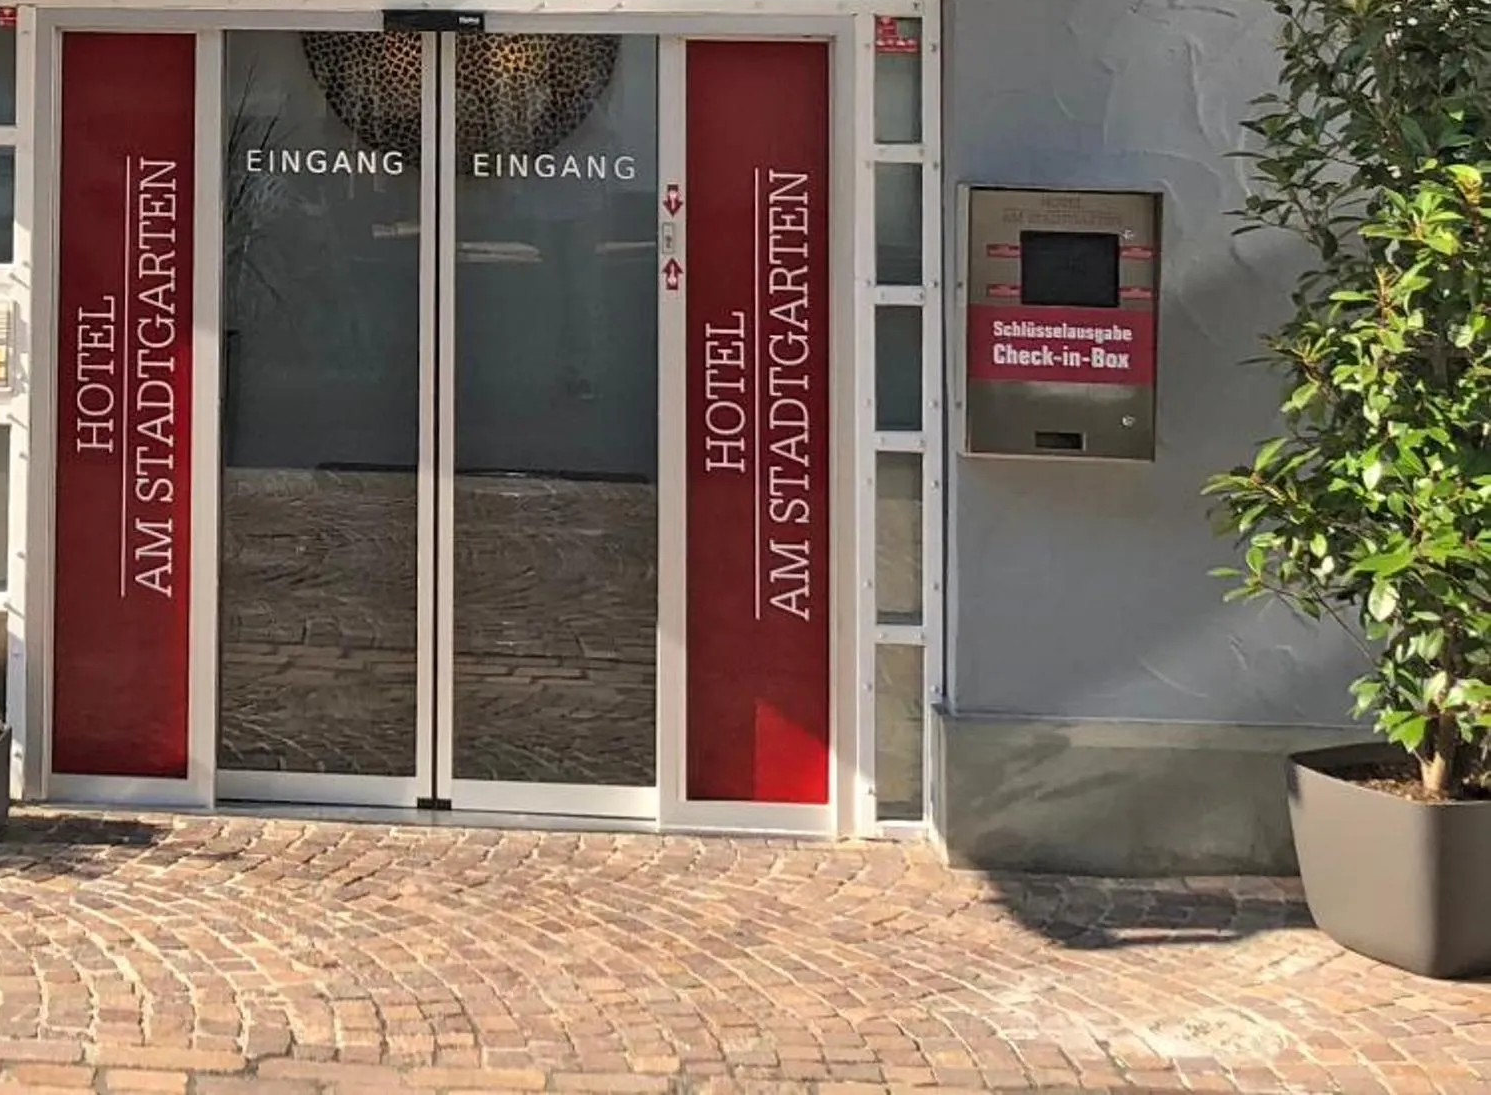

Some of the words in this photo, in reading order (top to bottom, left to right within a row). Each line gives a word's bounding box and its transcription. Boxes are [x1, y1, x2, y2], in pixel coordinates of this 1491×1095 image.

[246, 150, 405, 176] EINGANG
[472, 152, 636, 181] EINGANG
[135, 156, 176, 503] STADTGARTEN
[769, 169, 809, 524] STADTGARTEN
[993, 320, 1133, 343] Schlüsselausgabe
[993, 343, 1130, 369] Check-in-Box
[76, 295, 115, 453] HOTEL
[705, 311, 745, 473] HOTEL
[135, 517, 173, 598] AM
[769, 539, 809, 621] AM
